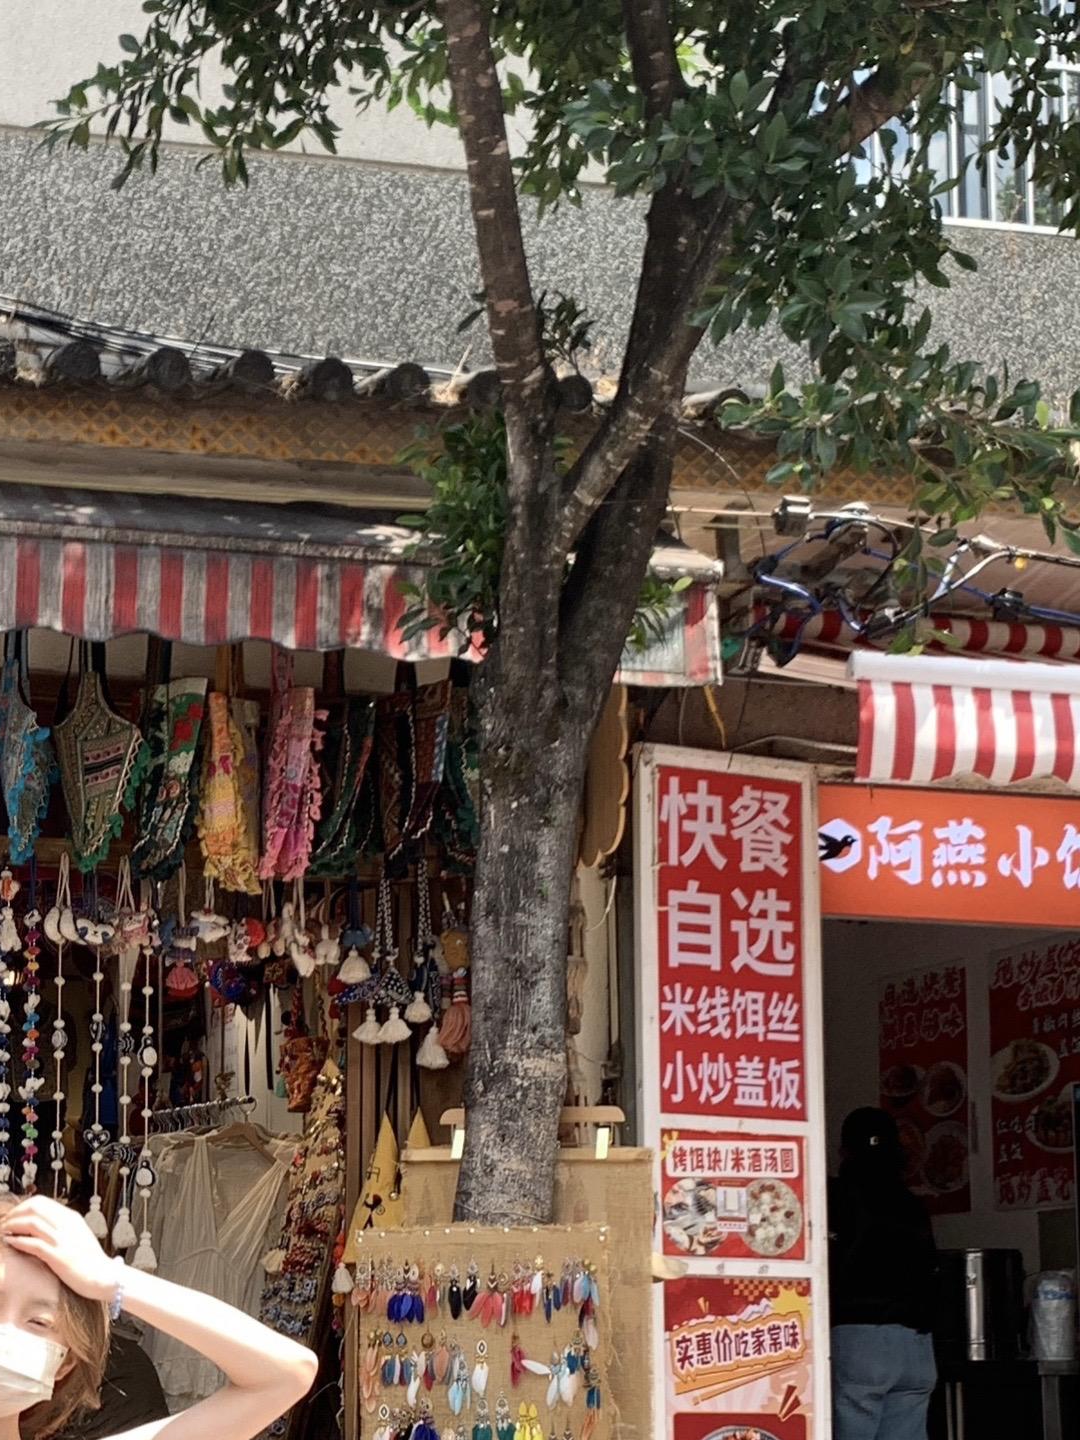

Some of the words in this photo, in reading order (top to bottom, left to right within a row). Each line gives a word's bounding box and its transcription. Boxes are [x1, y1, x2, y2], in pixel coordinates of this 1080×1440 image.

[659, 775, 795, 878] 快餐
[667, 880, 796, 977] 自选
[660, 983, 800, 1042] 米线饵丝
[662, 1050, 801, 1110] 小炒盖饭
[672, 1146, 795, 1173] 烤饵块/米酒汤圆
[675, 1321, 800, 1370] 实惠价吃家常味
